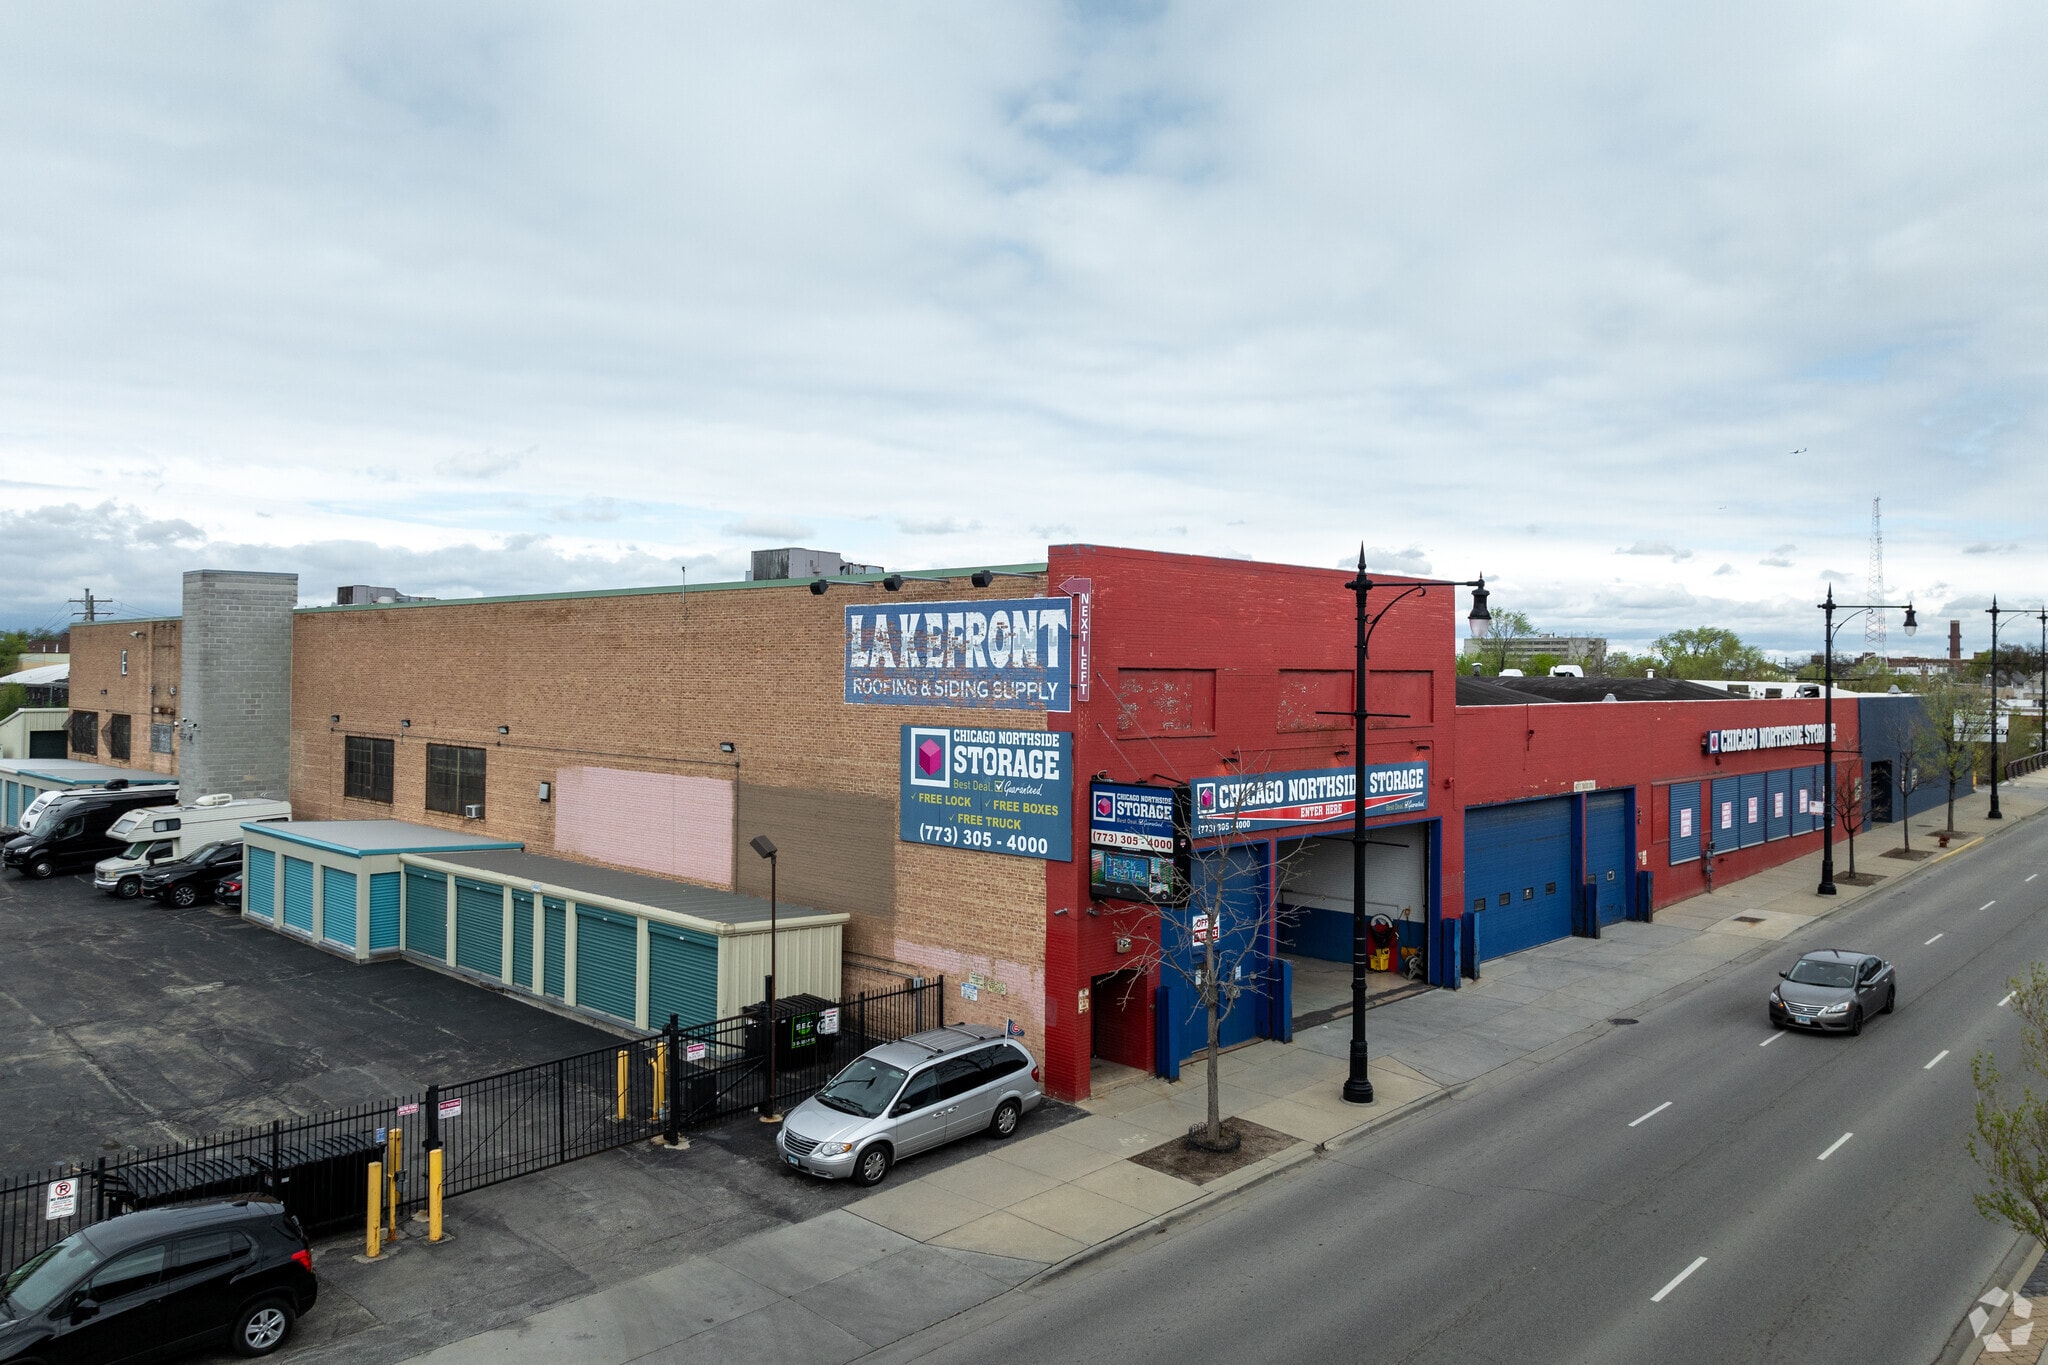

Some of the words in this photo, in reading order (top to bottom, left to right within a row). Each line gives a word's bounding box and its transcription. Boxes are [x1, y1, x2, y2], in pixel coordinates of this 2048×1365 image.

[1080, 593, 1089, 642] NEXT
[850, 609, 1067, 668] LAKEFRONT
[1080, 650, 1088, 695] LEFT
[853, 678, 917, 696] ROOFING
[921, 680, 931, 697] &
[935, 680, 987, 698] SIDING
[993, 682, 1058, 700] SUPPLY
[953, 729, 995, 744] CHICAGO
[998, 731, 1060, 747] NORTHSIDE
[1721, 728, 1758, 752] CHICAGO
[1759, 725, 1804, 748] NORTHSIDE
[1804, 723, 1836, 744] STORE
[953, 745, 1060, 780] STORAGE
[953, 779, 971, 790] Best
[1219, 780, 1284, 809] CHICAGO
[1288, 774, 1356, 801] NORTHSID
[1370, 768, 1423, 793] STORAGE
[919, 793, 942, 805] FREE
[945, 795, 971, 807] LOCK
[1117, 793, 1140, 801] CHICAGO
[1141, 795, 1172, 804] NORTHSIDE
[993, 800, 1019, 812] FREE
[1023, 803, 1059, 816] BOXES
[1117, 802, 1172, 820] STORAGE
[1300, 804, 1323, 818] ENTER
[1325, 803, 1342, 815] HERE
[957, 813, 983, 826] FREE
[986, 816, 1022, 830] TRUCK
[1198, 825, 1215, 834] (773)
[919, 823, 958, 845] (773)
[963, 830, 992, 847] 305
[1007, 835, 1048, 854] 4000
[1093, 831, 1117, 844] (773)
[1120, 835, 1138, 846] 305
[1148, 838, 1172, 849] 4000
